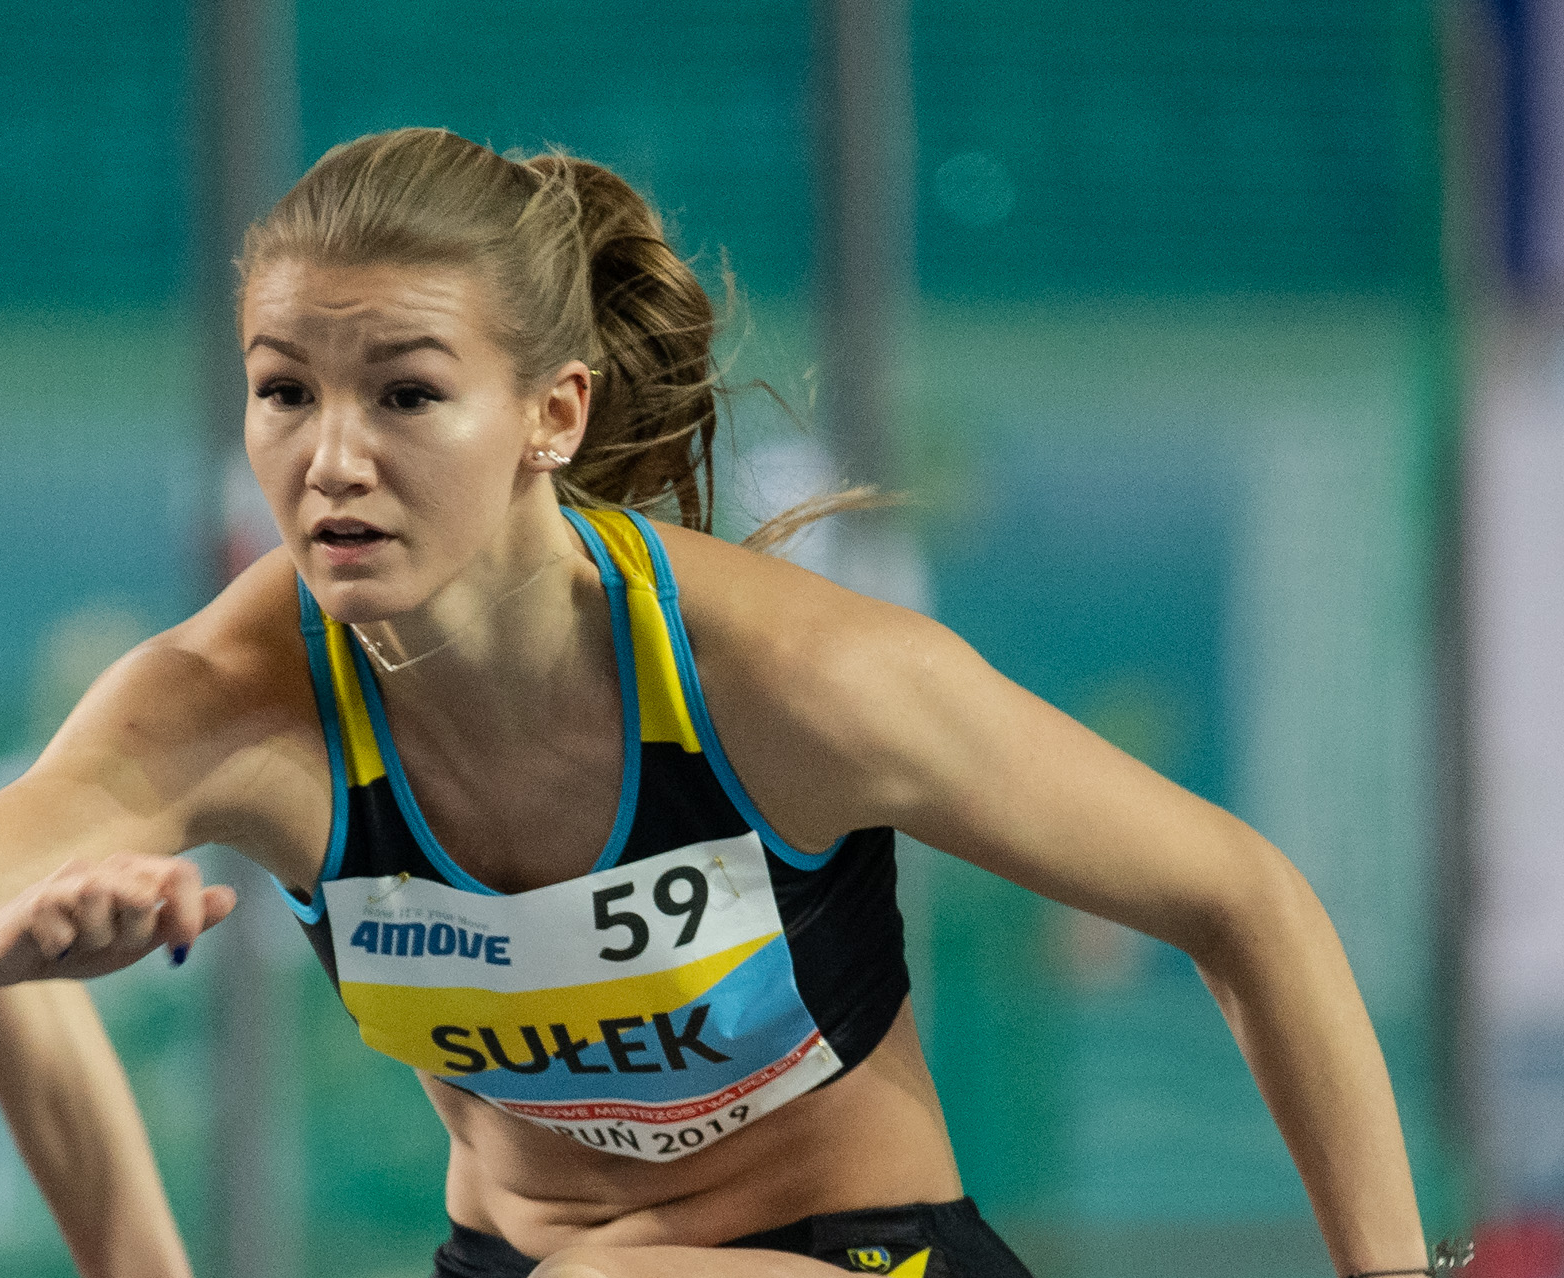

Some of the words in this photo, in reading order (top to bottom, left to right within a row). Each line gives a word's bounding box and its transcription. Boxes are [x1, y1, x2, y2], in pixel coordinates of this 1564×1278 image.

[592, 865, 710, 962] 59
[430, 1003, 733, 1075] SUŁEK
[651, 1104, 750, 1154] 2019
